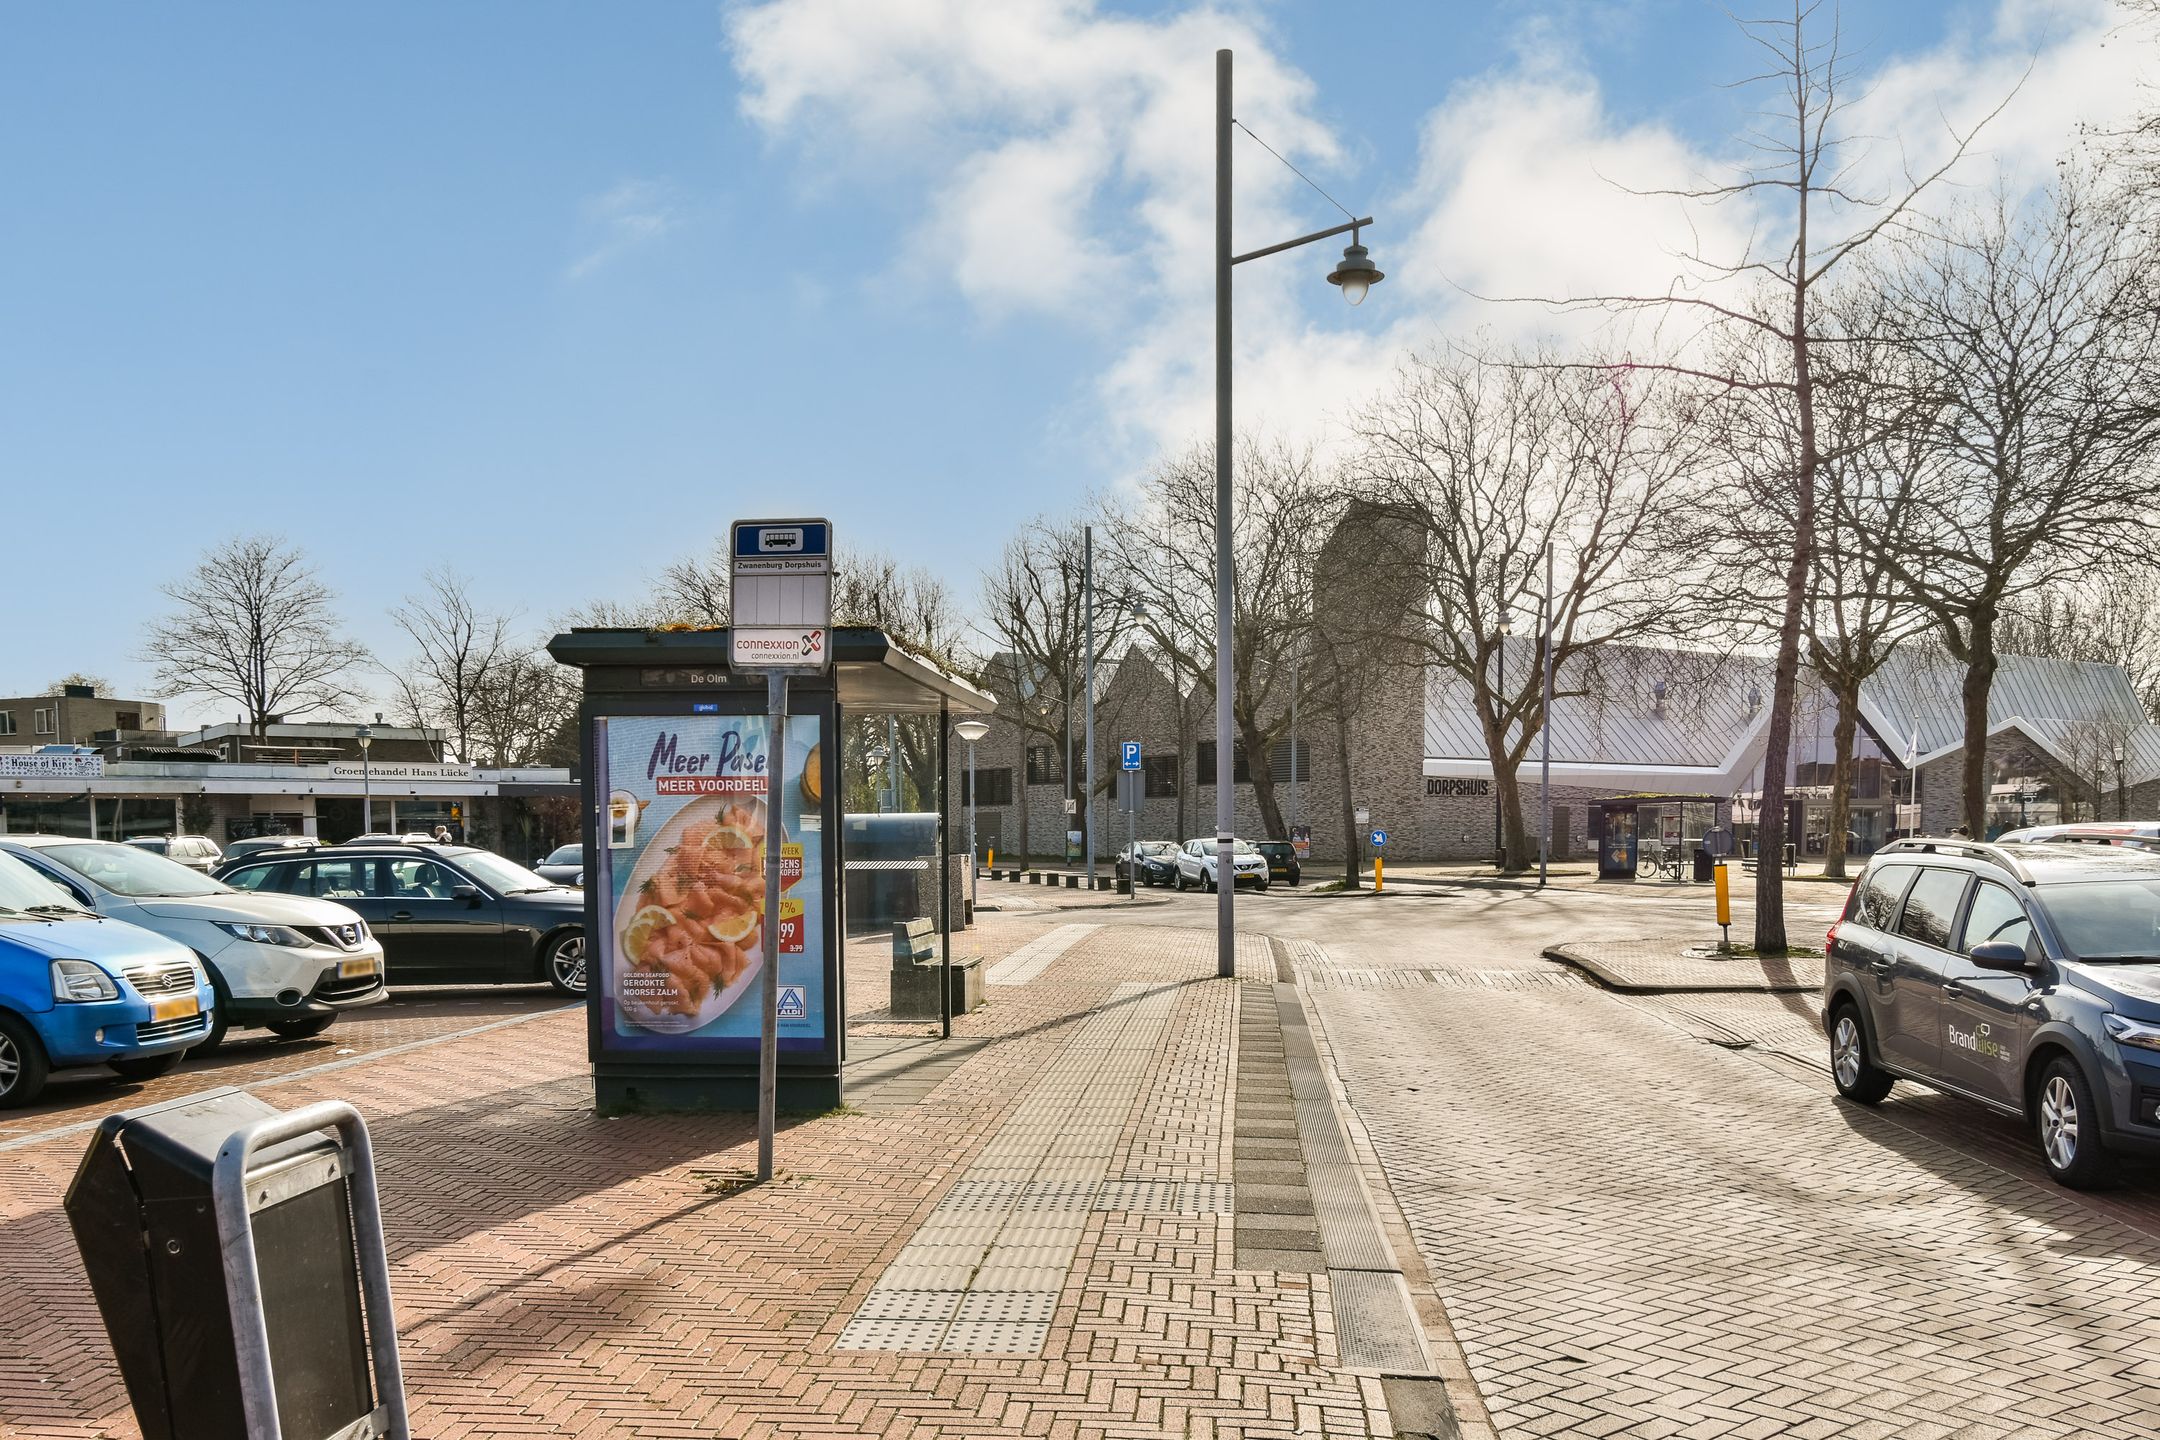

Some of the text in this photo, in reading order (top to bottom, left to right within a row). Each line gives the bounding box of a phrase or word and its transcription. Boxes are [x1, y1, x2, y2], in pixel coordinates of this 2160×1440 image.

[738, 561, 822, 570] Zwanenburg Dorpshuis
[736, 640, 800, 650] connexxion
[751, 651, 800, 660] connexxion.nl
[691, 674, 728, 684] De Olm
[646, 730, 769, 780] Meer Pase
[1126, 745, 1137, 760] P
[11, 758, 67, 769] House of Kip
[333, 766, 469, 777] Groenehandel Hans Lücke
[658, 779, 769, 792] MEER VOORDEEL
[1427, 779, 1489, 796] DORPSHUIS
[623, 979, 665, 987] GEROOKTE
[623, 988, 678, 996] NOORSE ZALM
